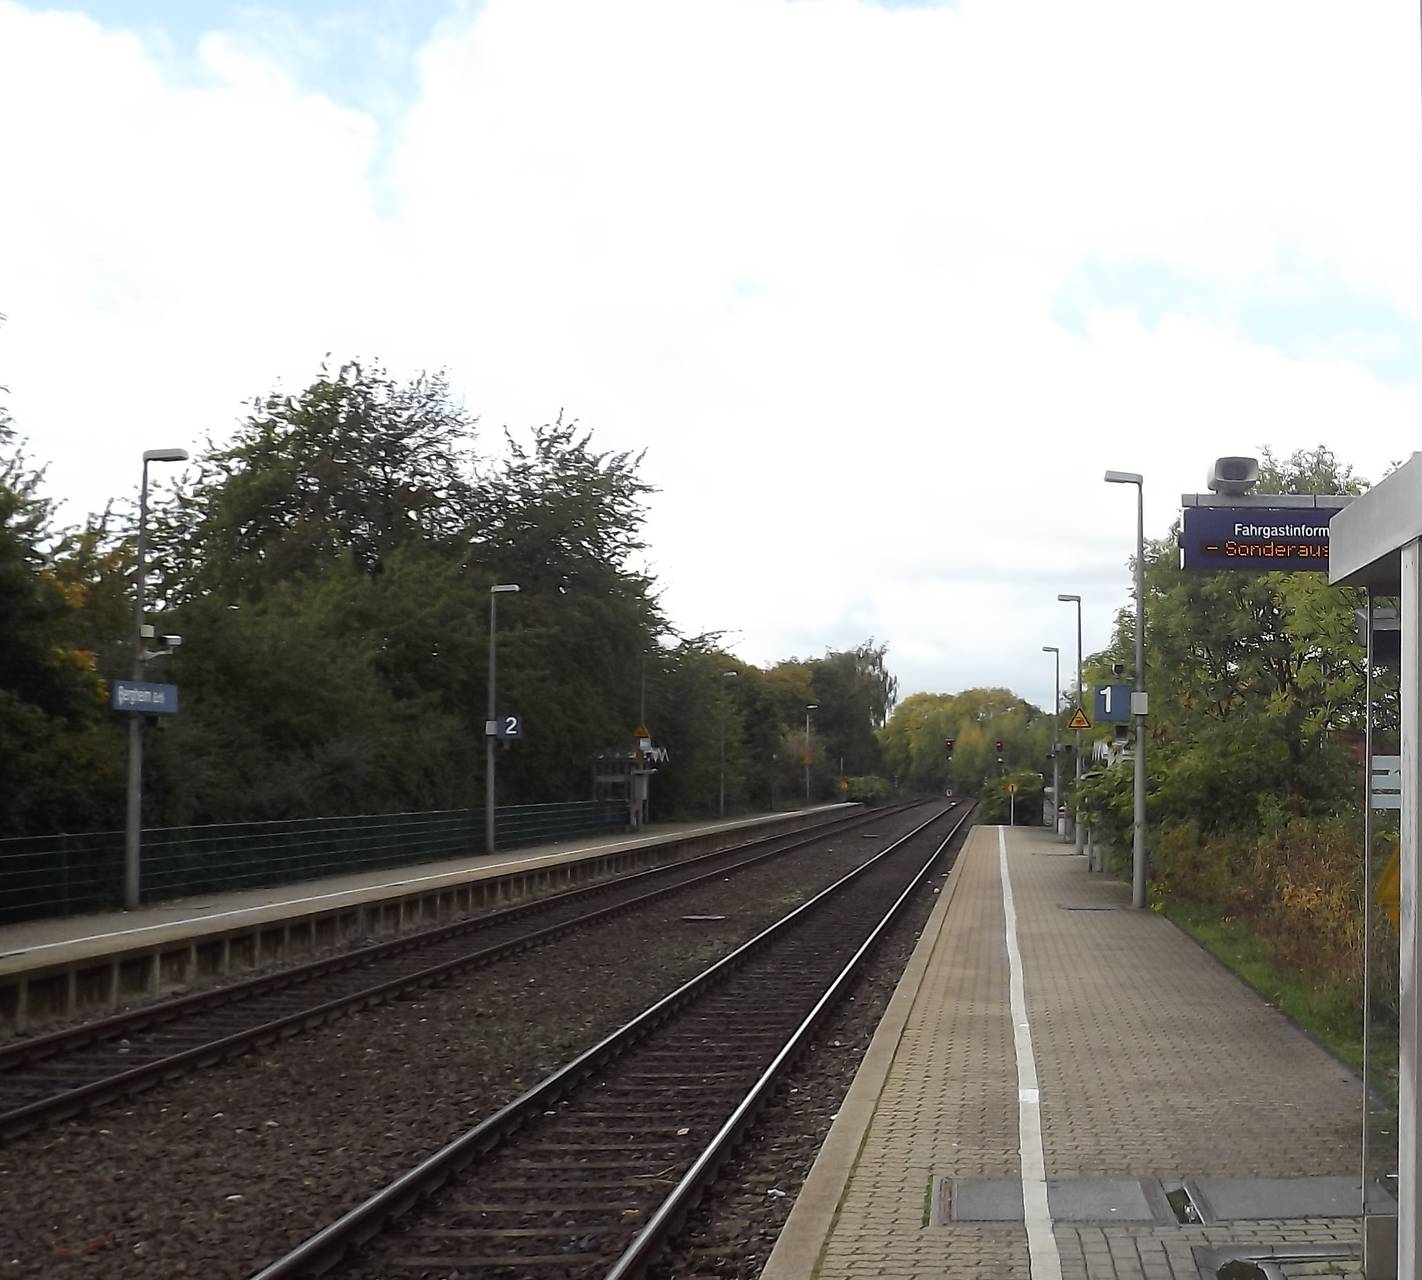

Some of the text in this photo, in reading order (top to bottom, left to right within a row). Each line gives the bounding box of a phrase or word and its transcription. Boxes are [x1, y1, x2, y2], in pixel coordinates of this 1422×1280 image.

[1234, 523, 1330, 539] Fahrgastinform
[1100, 686, 1111, 713] 1
[505, 716, 518, 734] 2
